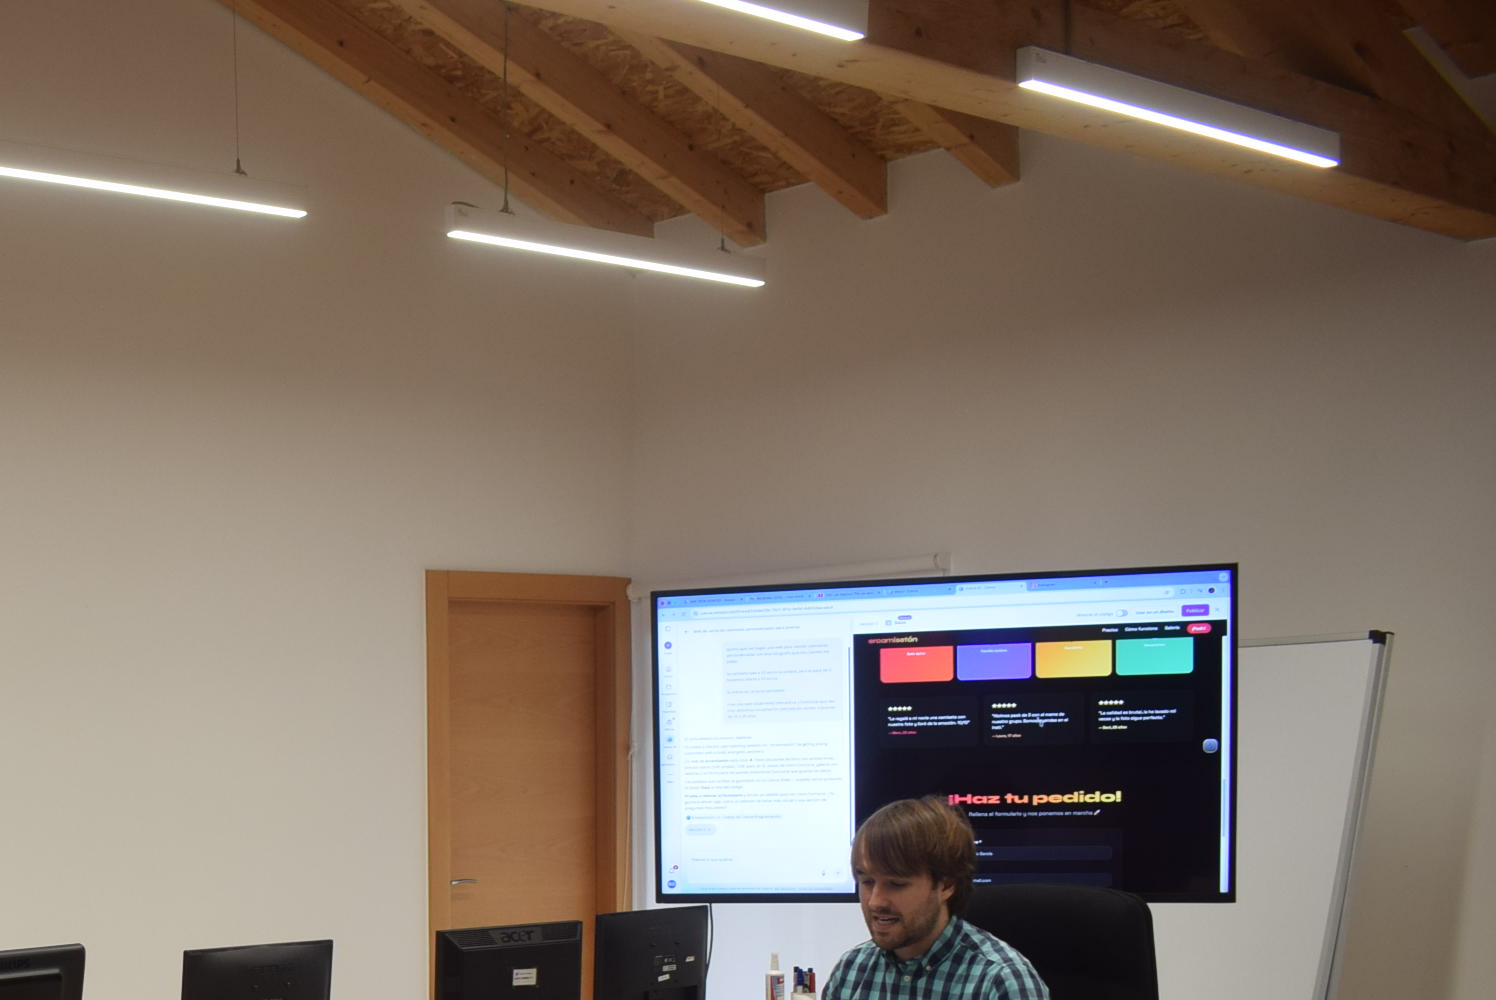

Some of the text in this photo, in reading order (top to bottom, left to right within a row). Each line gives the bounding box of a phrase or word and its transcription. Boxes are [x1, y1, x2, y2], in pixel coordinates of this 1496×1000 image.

[948, 790, 1122, 806] ¡Haz tu pedido!
